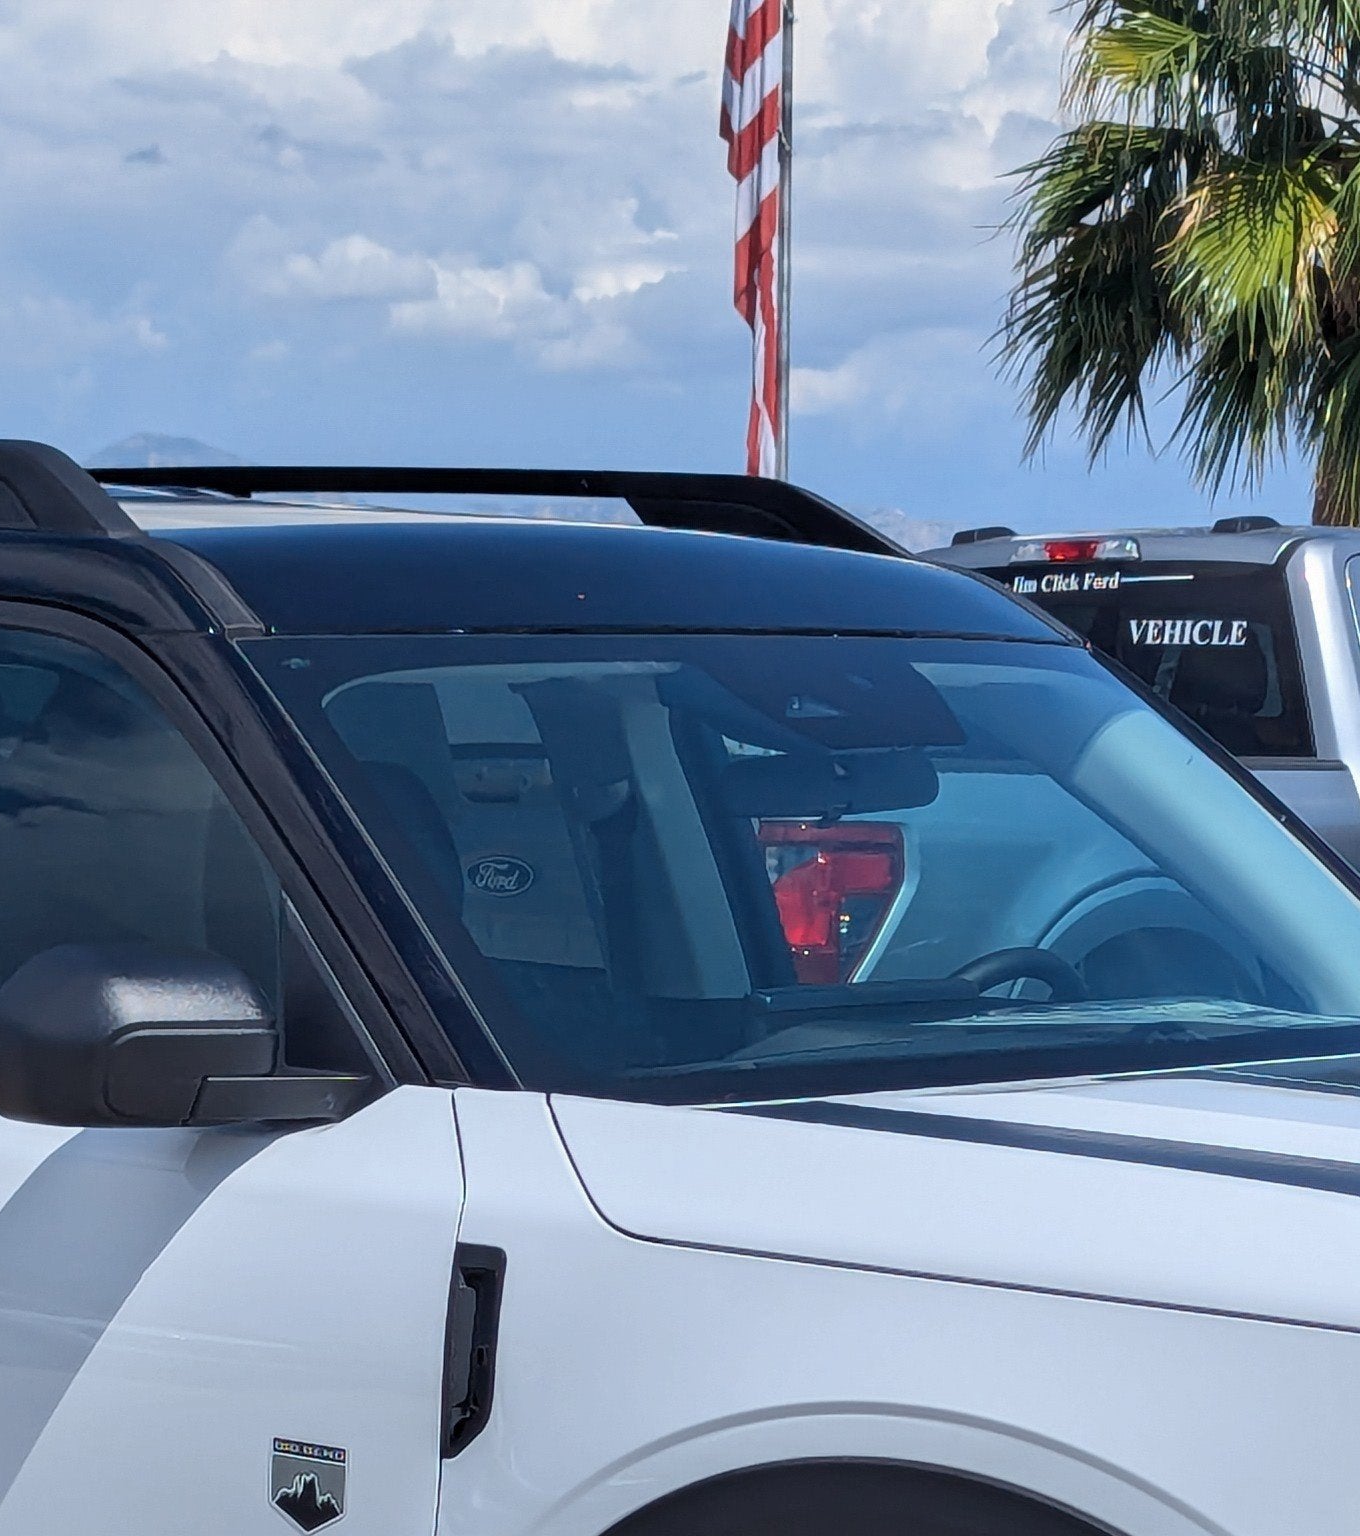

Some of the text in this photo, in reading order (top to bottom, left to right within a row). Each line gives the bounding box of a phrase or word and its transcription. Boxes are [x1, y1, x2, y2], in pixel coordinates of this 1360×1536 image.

[1041, 574, 1078, 592] Click
[1083, 571, 1120, 590] Ford
[1129, 619, 1247, 646] VEHICLE
[476, 863, 519, 889] Ford
